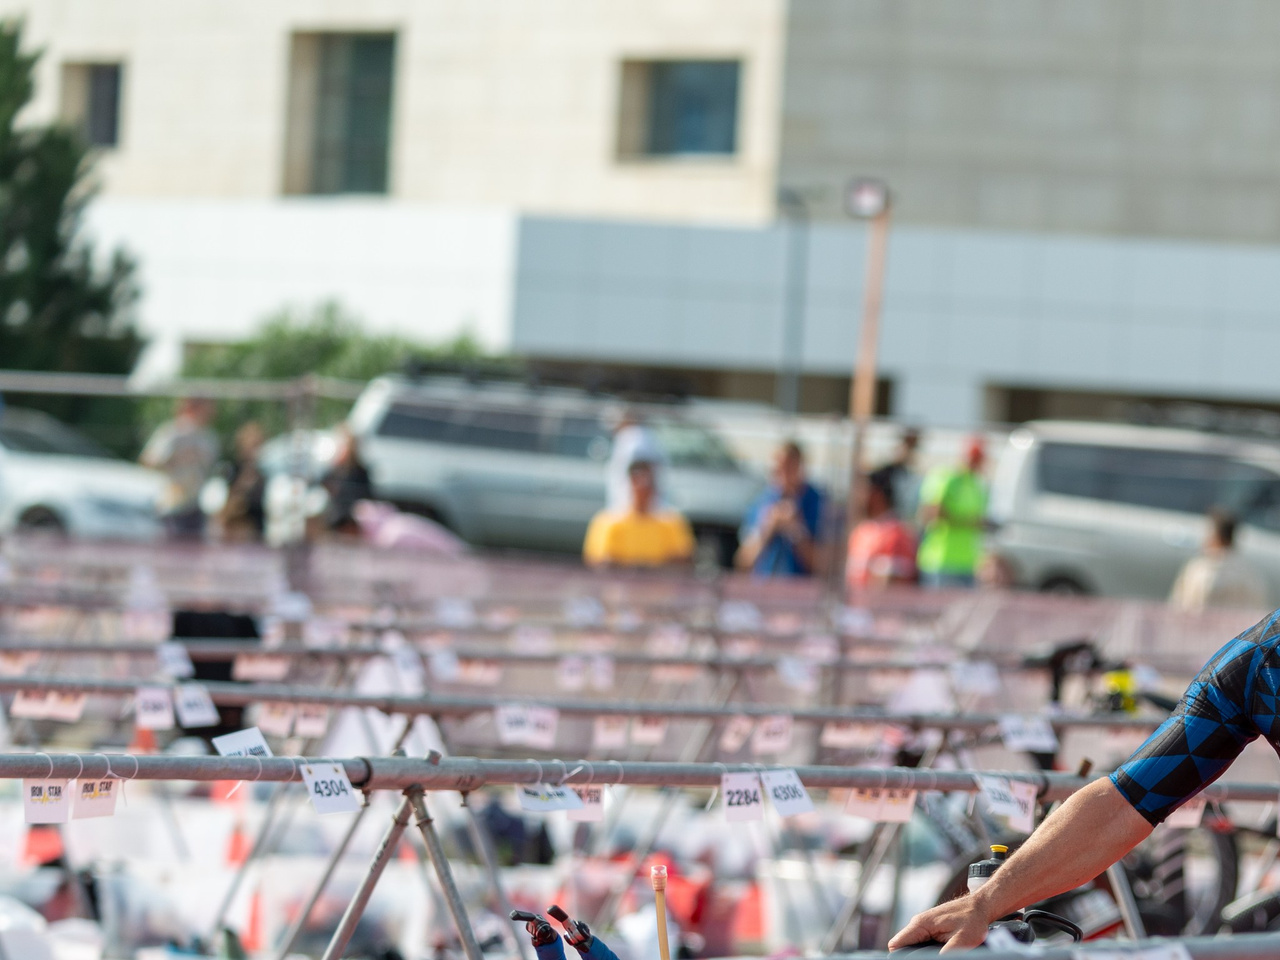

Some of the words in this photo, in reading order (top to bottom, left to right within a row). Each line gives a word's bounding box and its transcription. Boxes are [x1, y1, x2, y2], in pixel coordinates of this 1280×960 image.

[30, 785, 43, 797] IRON
[48, 785, 62, 796] STAR
[99, 781, 113, 792] STAR
[314, 779, 348, 798] 4304
[726, 788, 760, 806] 2284
